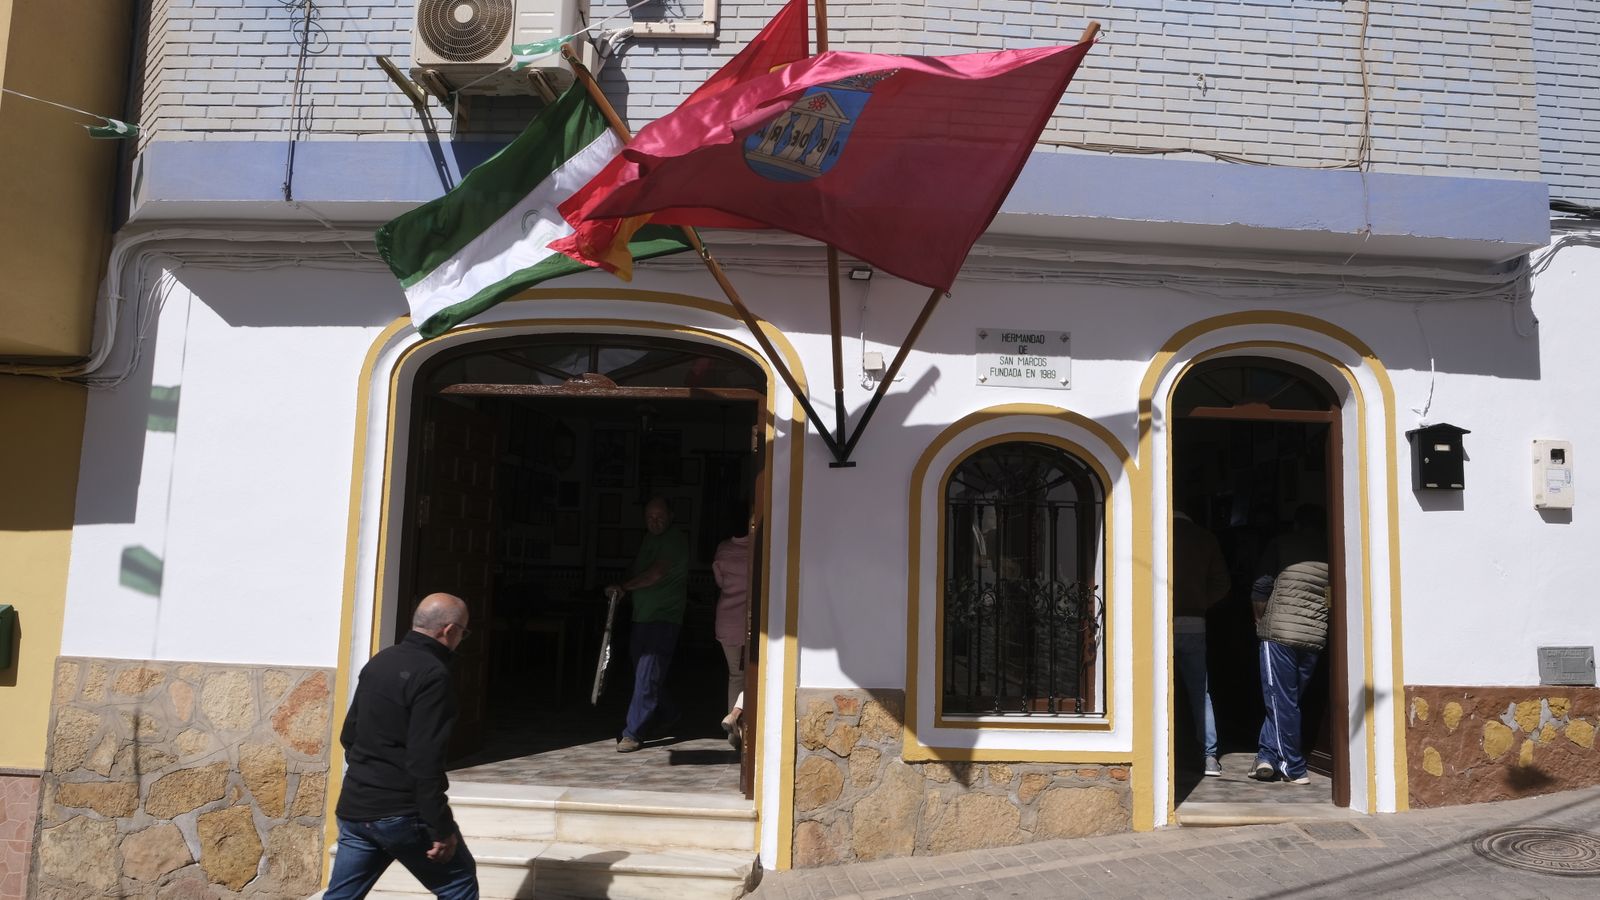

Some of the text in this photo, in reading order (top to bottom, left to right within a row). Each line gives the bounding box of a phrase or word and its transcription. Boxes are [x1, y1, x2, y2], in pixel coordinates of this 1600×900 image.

[1001, 333, 1045, 344] HERMANDAD
[1018, 345, 1028, 355] DE
[999, 356, 1047, 367] SAN MARCOS
[989, 367, 1056, 379] FUNDADA EN 1989
